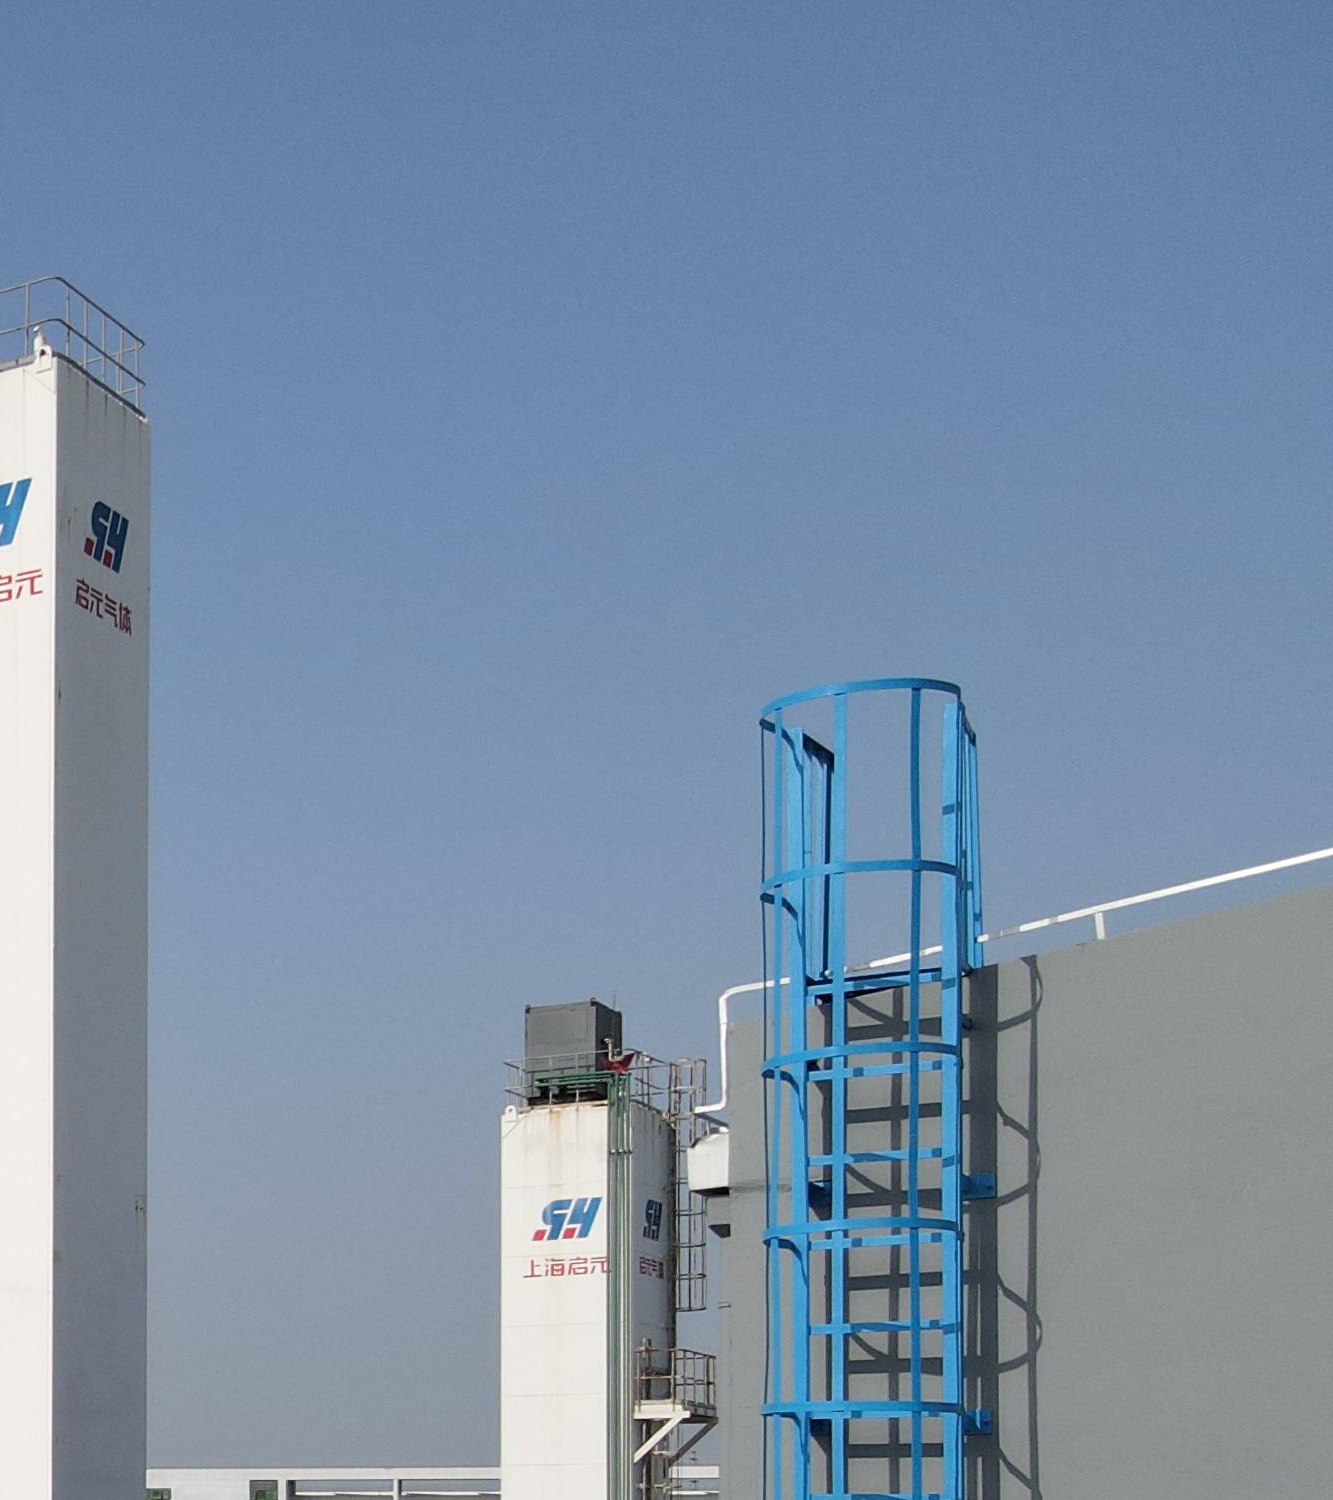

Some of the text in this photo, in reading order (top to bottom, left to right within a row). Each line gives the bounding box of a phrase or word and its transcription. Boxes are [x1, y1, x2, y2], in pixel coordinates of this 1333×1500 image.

[75, 578, 132, 636] 启元气体
[523, 1257, 612, 1278] 上海启元
